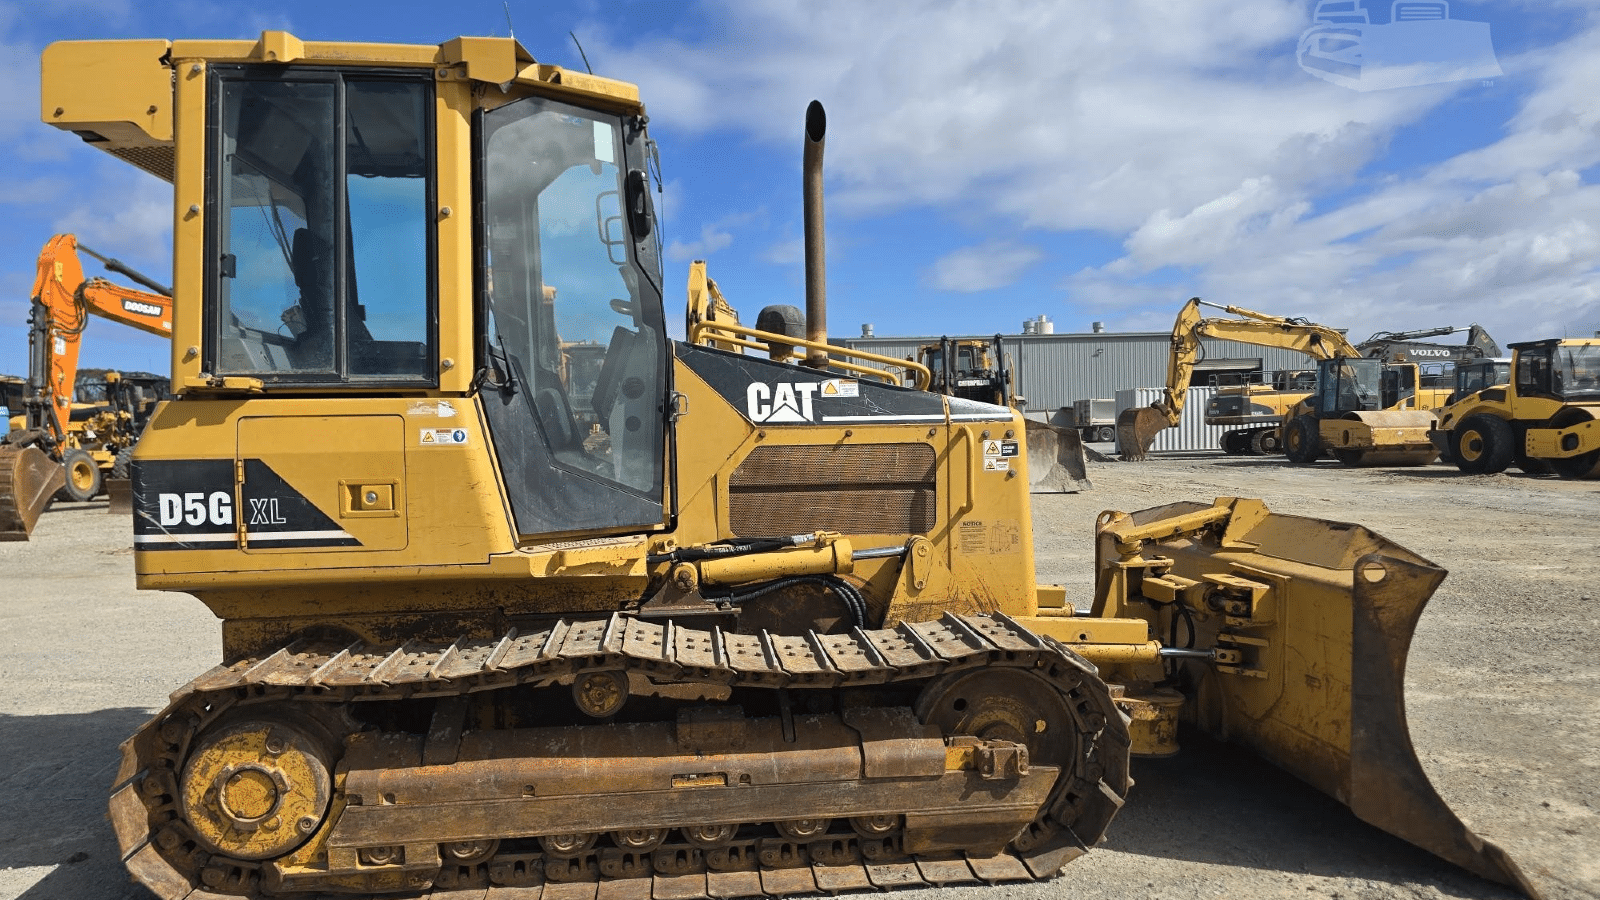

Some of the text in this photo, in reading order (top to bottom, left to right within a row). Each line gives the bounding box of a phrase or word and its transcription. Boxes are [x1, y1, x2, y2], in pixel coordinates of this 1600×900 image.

[124, 300, 162, 316] DOOSAN
[1410, 349, 1451, 357] VOLVO
[746, 381, 818, 422] CAT
[158, 491, 287, 526] D5G XL
